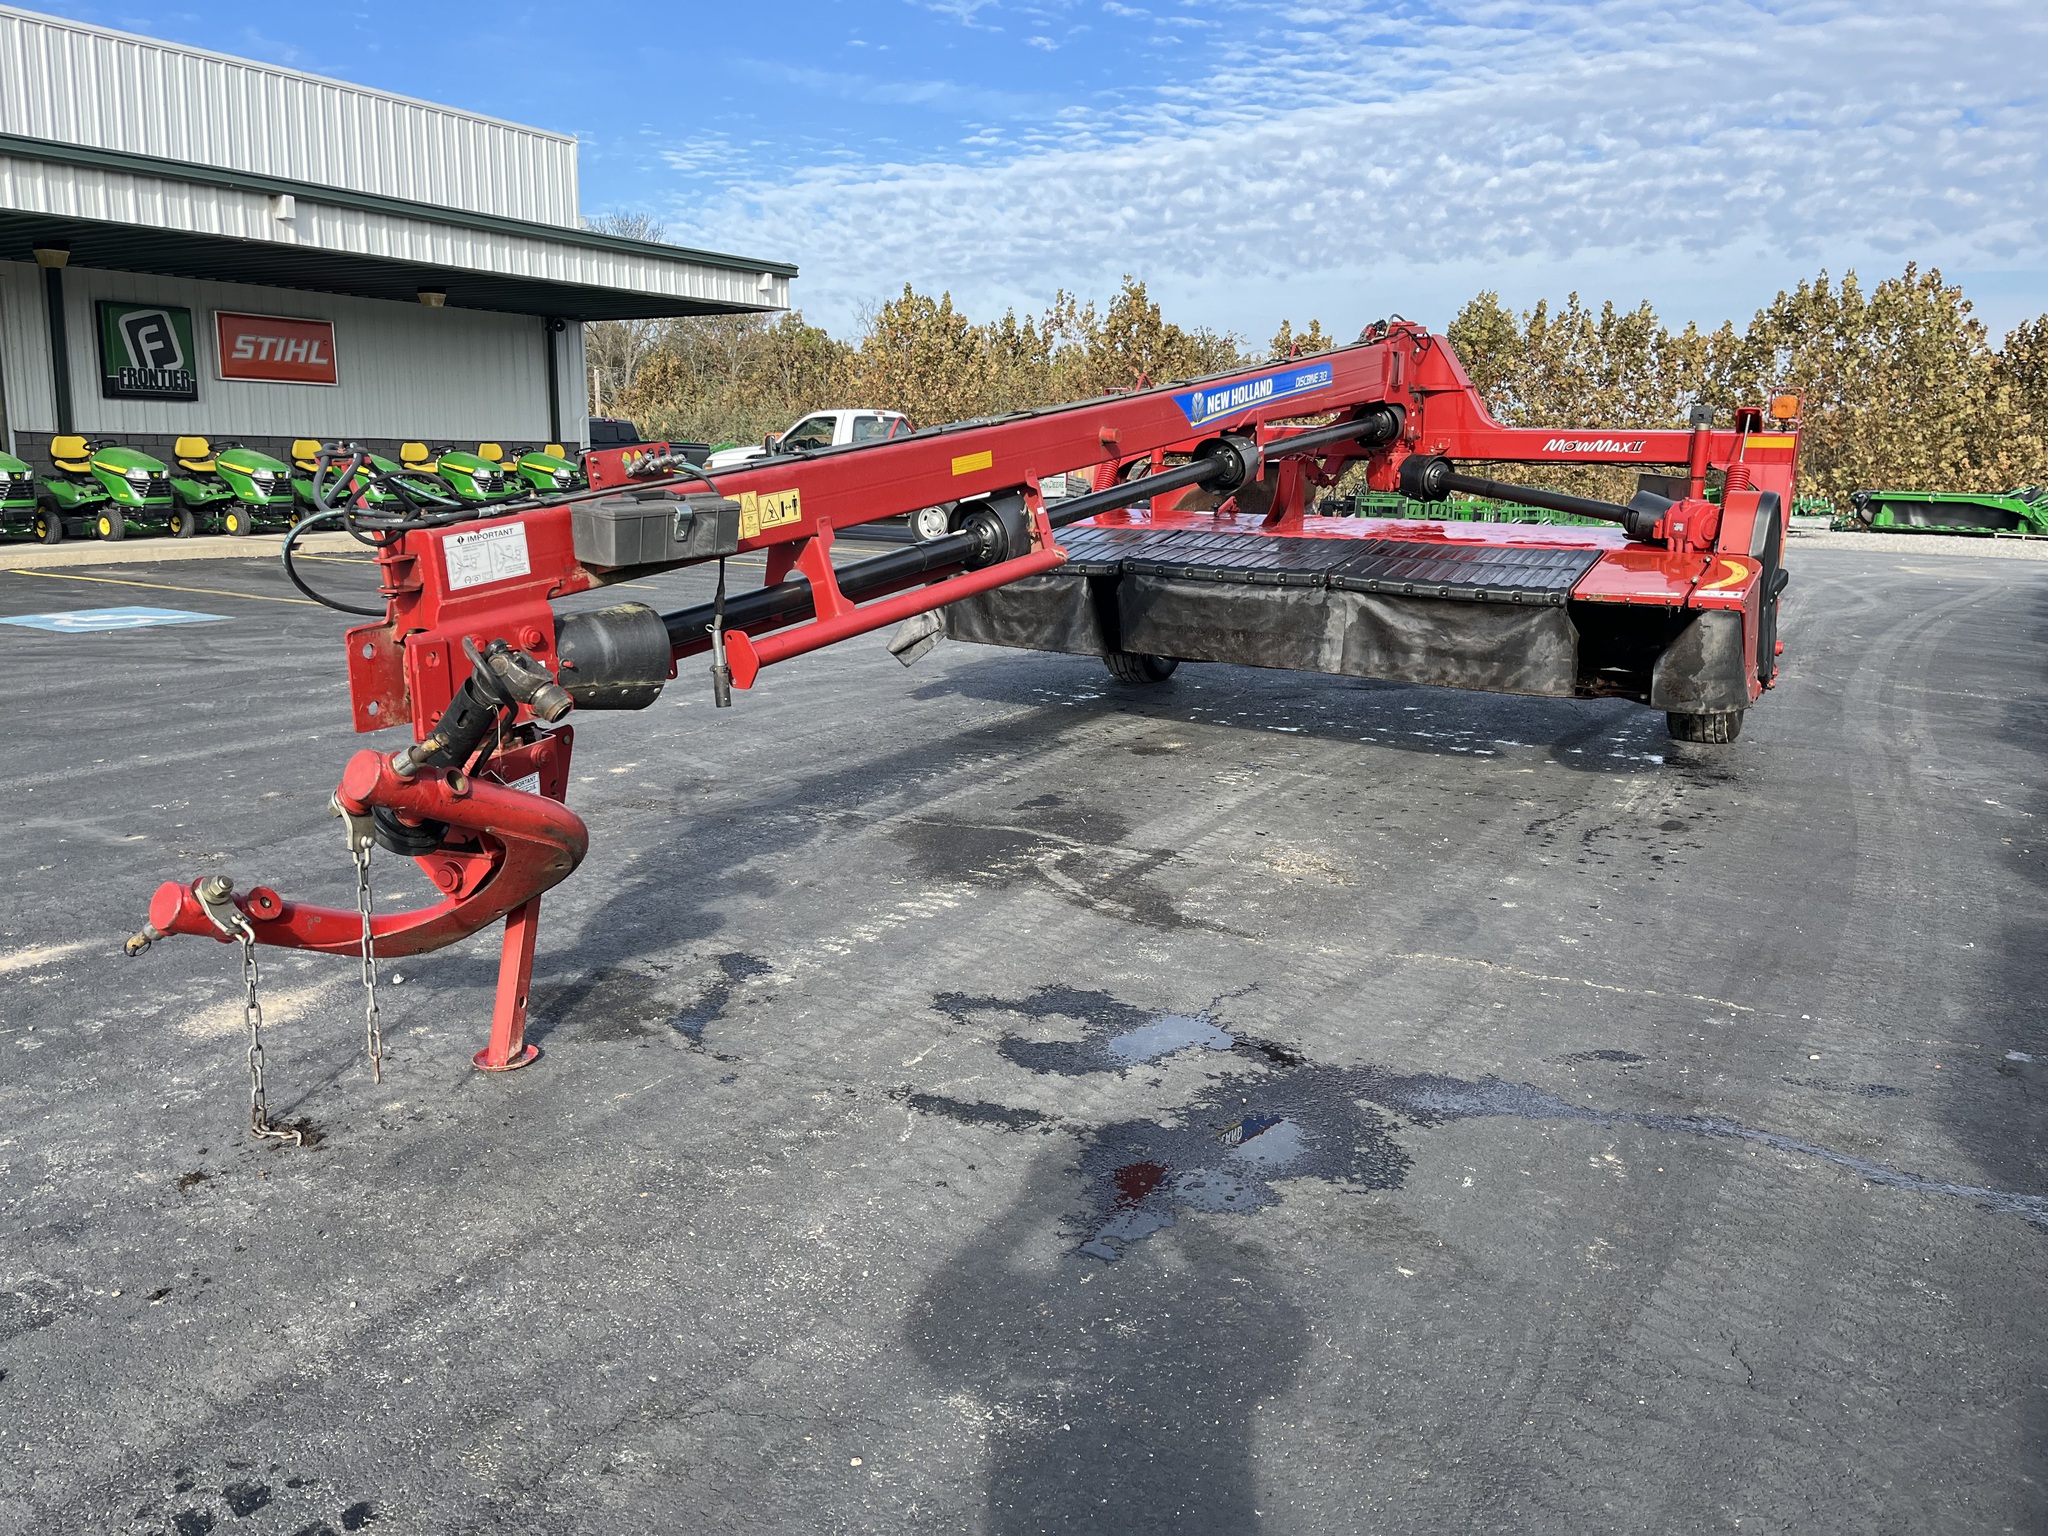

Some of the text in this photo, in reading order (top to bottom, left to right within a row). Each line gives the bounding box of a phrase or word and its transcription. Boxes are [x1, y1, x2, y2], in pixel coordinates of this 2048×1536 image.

[231, 334, 329, 365] STIHL
[119, 367, 190, 389] FRONTIER
[1206, 390, 1230, 414] NEW
[1231, 378, 1273, 407] HOLLAND
[467, 528, 513, 542] IMPORTANT
